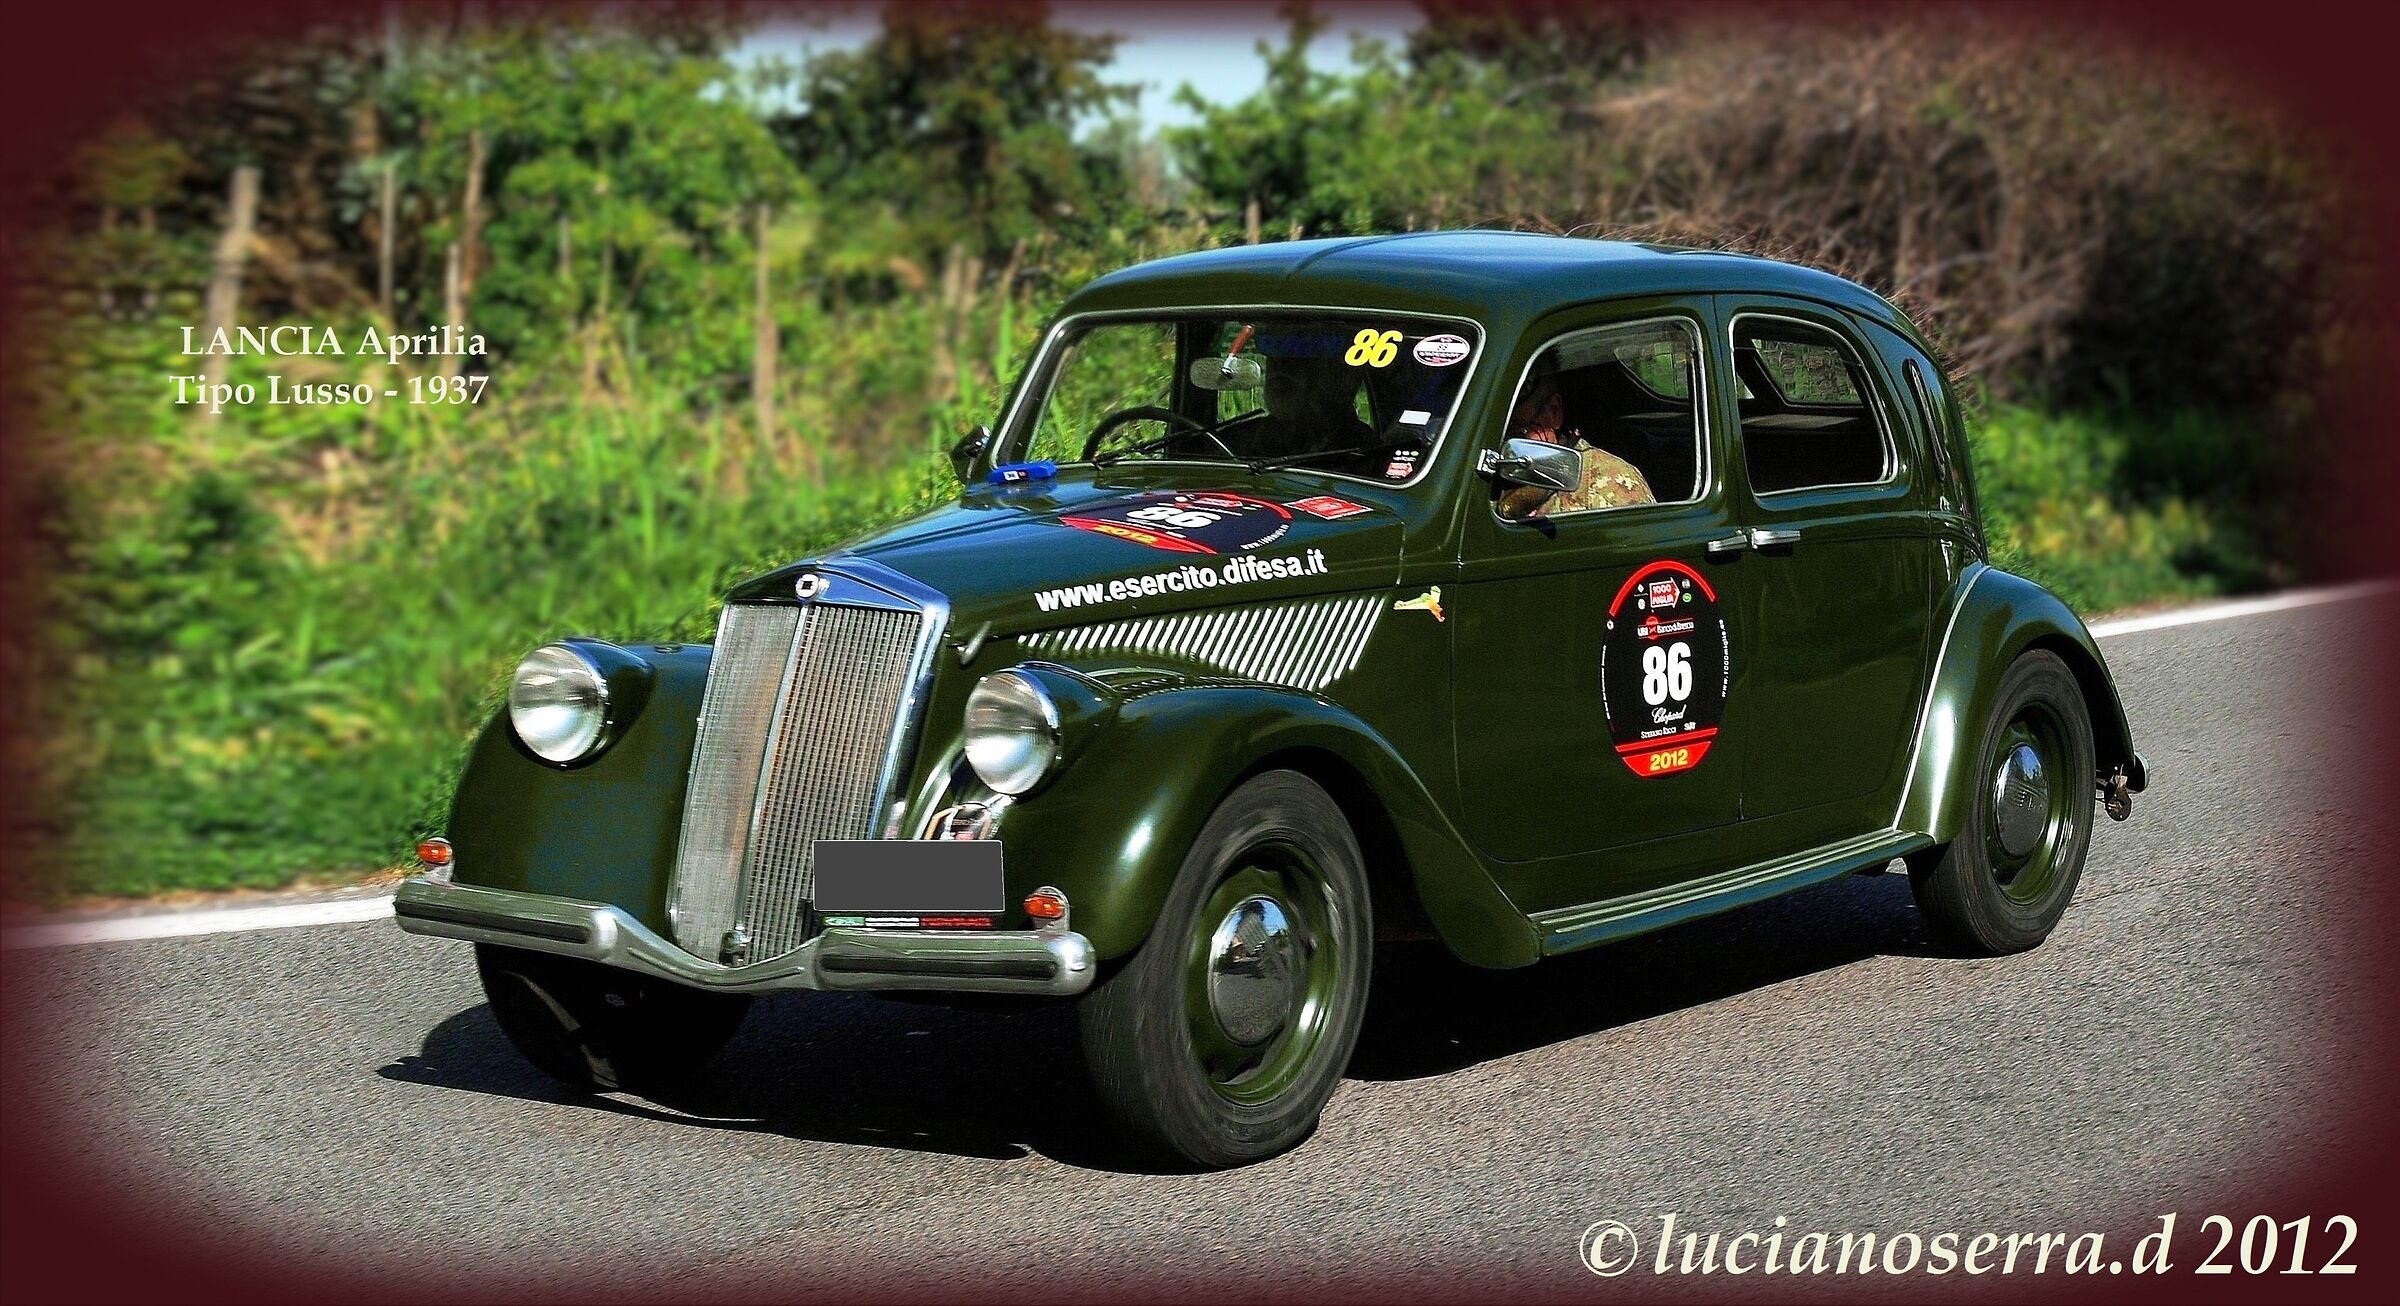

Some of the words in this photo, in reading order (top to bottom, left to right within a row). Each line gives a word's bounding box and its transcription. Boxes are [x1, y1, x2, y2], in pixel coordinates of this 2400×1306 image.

[1344, 328, 1403, 368] 86
[1125, 506, 1222, 528] 86
[1096, 524, 1158, 544] 2012
[1035, 548, 1329, 612] www.esercito.difesa.it
[1652, 584, 1672, 594] 1000
[1642, 641, 1693, 706] 86
[1650, 748, 1689, 772] 2012
